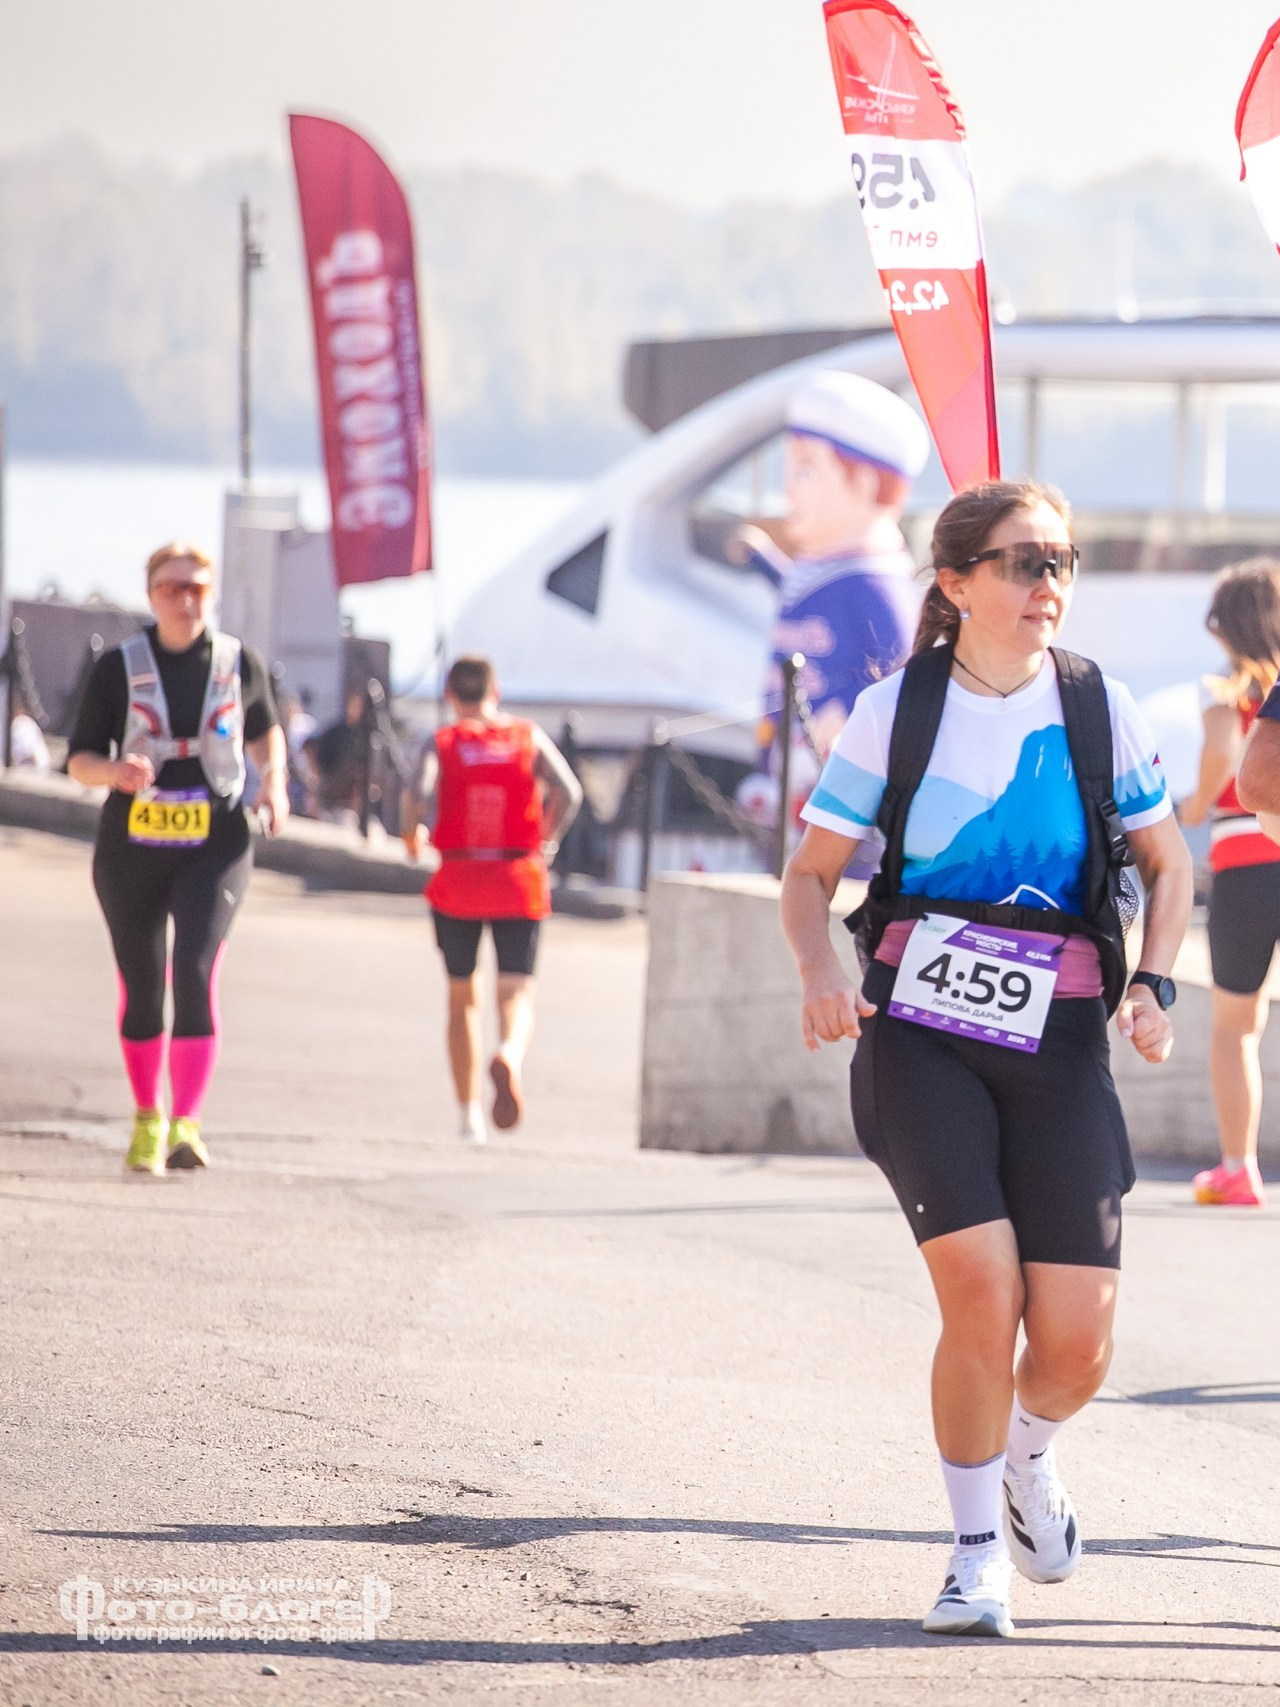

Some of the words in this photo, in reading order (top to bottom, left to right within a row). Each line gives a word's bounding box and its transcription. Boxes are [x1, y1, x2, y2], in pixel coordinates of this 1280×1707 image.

[136, 806, 202, 832] 4301
[916, 952, 1033, 1013] 4:59
[931, 998, 971, 1015] ЛИПОВА
[971, 1009, 1004, 1022] ДАРЬЯ
